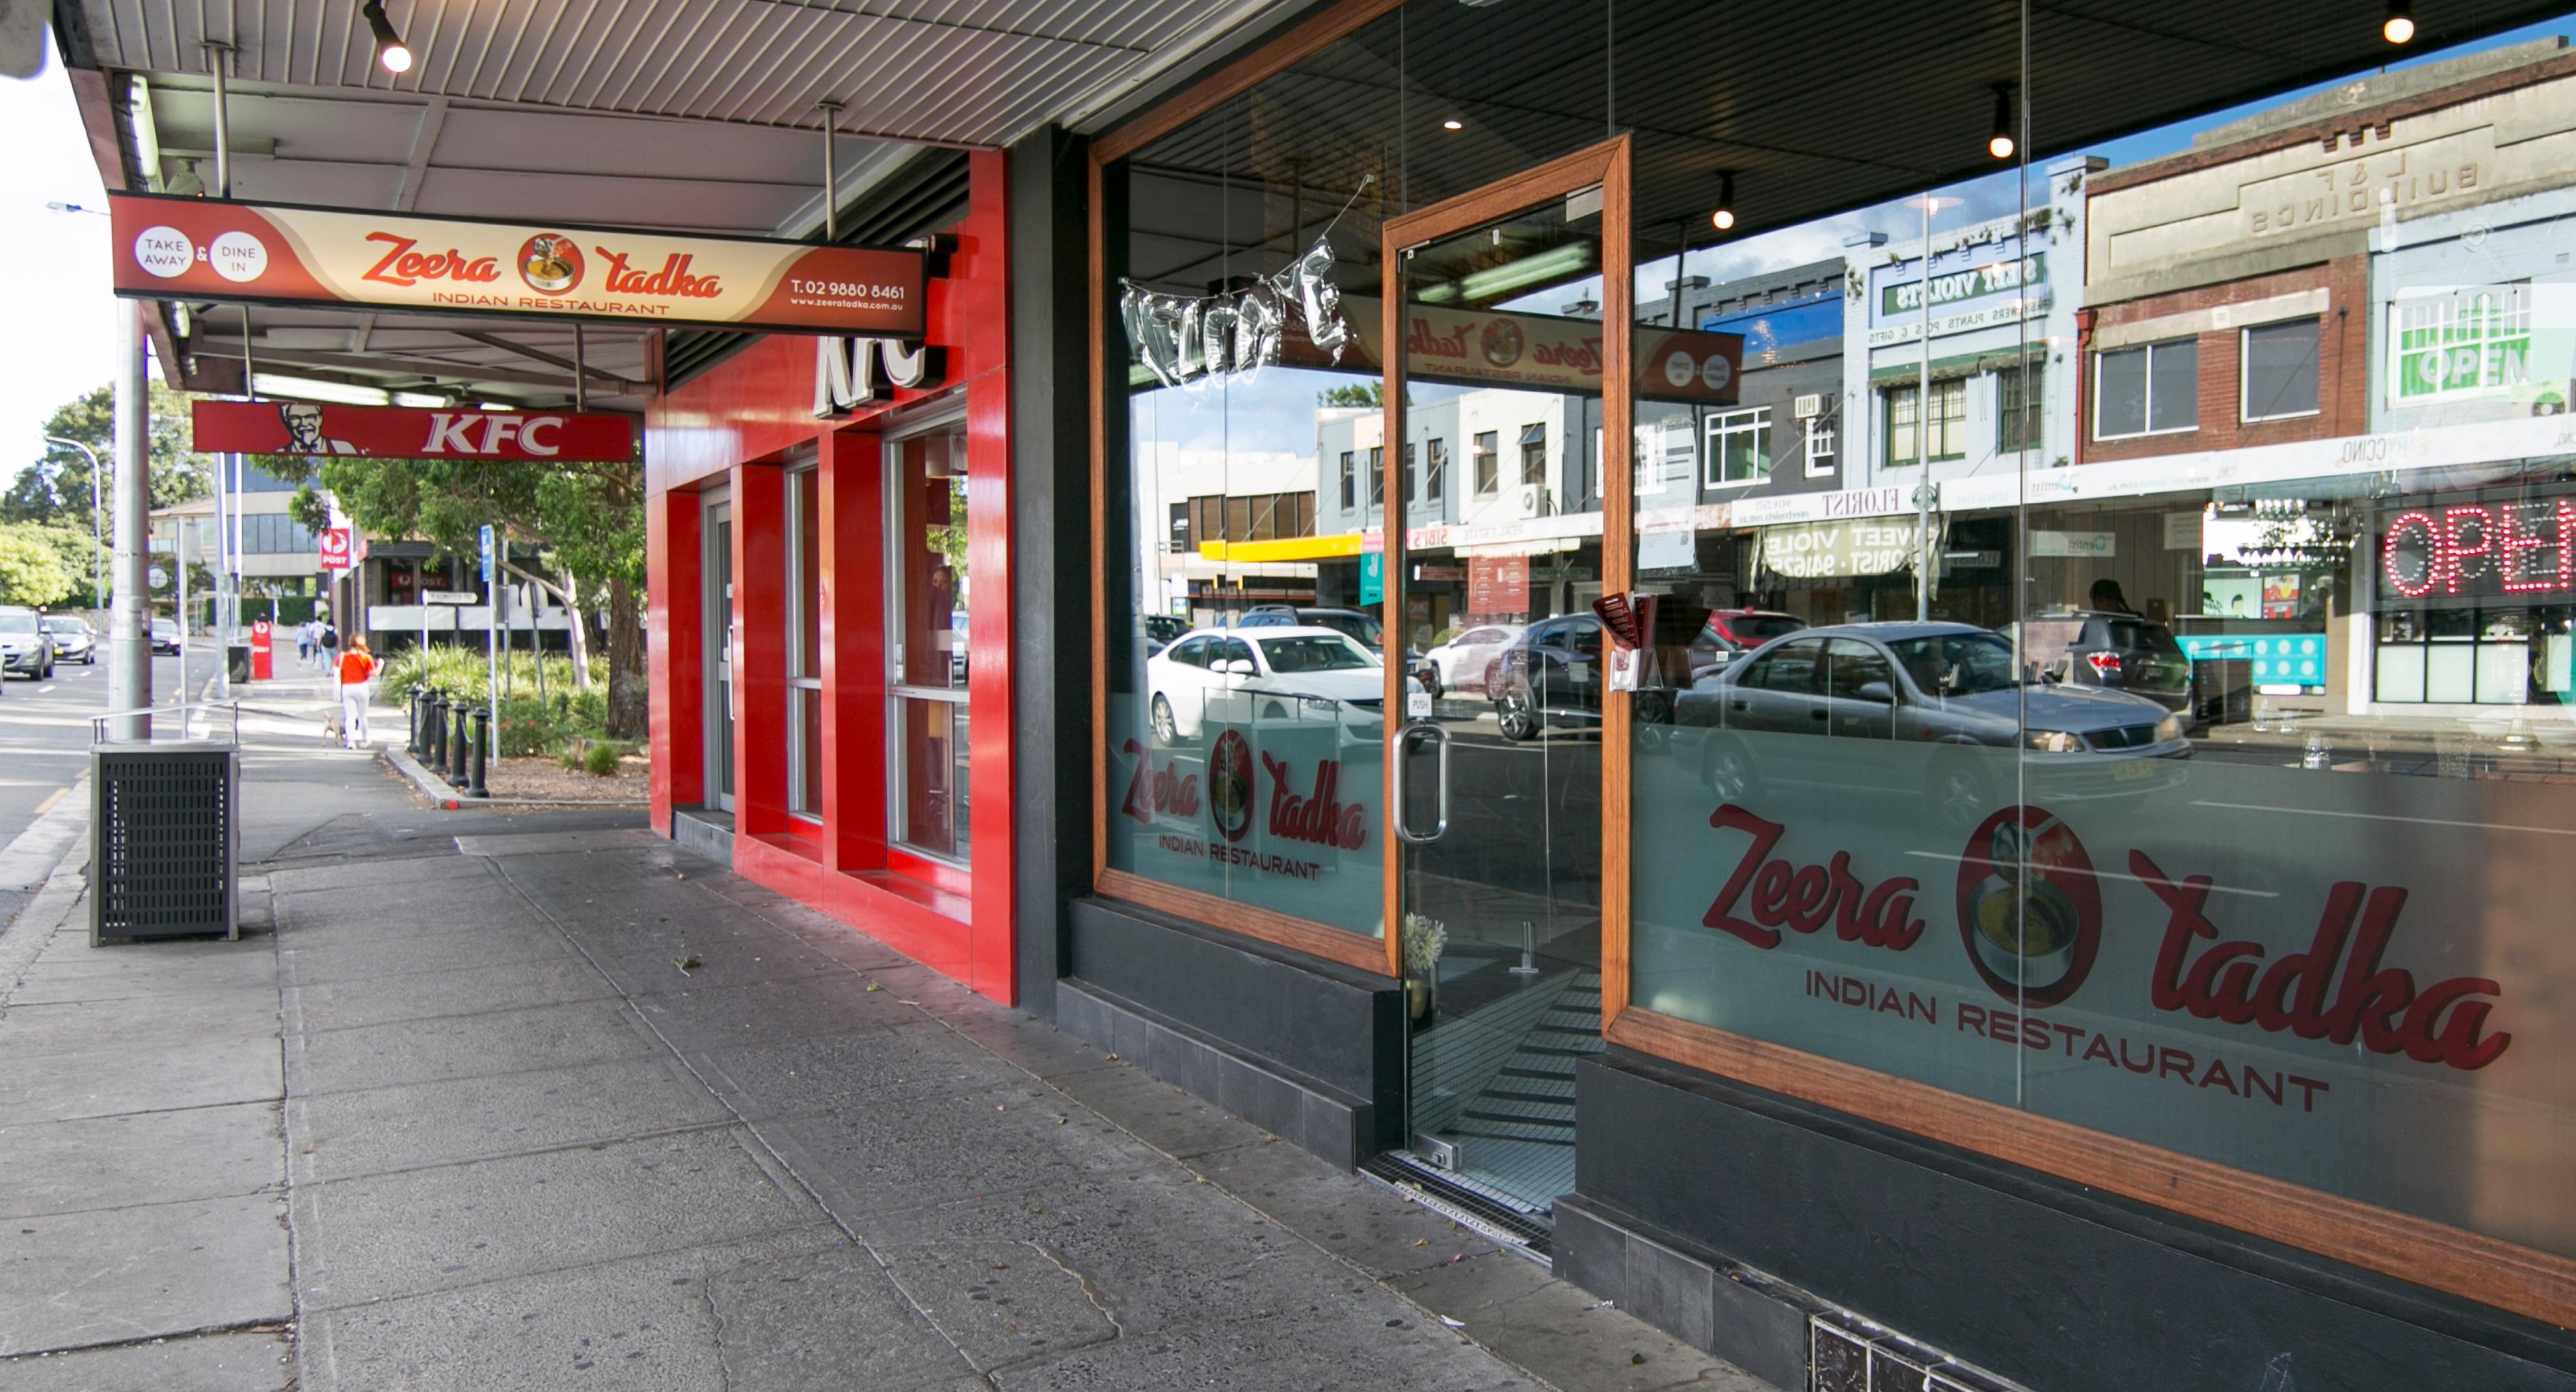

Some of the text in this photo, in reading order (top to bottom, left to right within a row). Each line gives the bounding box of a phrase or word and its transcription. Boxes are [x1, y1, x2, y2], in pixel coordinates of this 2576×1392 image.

[144, 238, 184, 252] TAKE
[196, 245, 208, 261] &
[222, 246, 256, 259] DINE
[144, 254, 187, 268] AWAY
[231, 261, 247, 273] IN
[361, 232, 502, 287] Zeera
[829, 282, 866, 297] 9880
[872, 285, 904, 299] 8461
[433, 292, 670, 315] INDIAN RESTAURANT
[791, 298, 903, 311] www.zeeratadka.com.au
[2419, 349, 2532, 386] OPEN
[422, 413, 561, 456] KFC
[323, 555, 347, 565] POST
[1412, 699, 1429, 711] PUSH
[1121, 738, 1200, 825] Zeera
[1158, 833, 1321, 882] INDIAN RESTAURANT
[1702, 803, 1925, 952] Zeera
[1806, 969, 2330, 1113] INDIAN RESTAURANT
